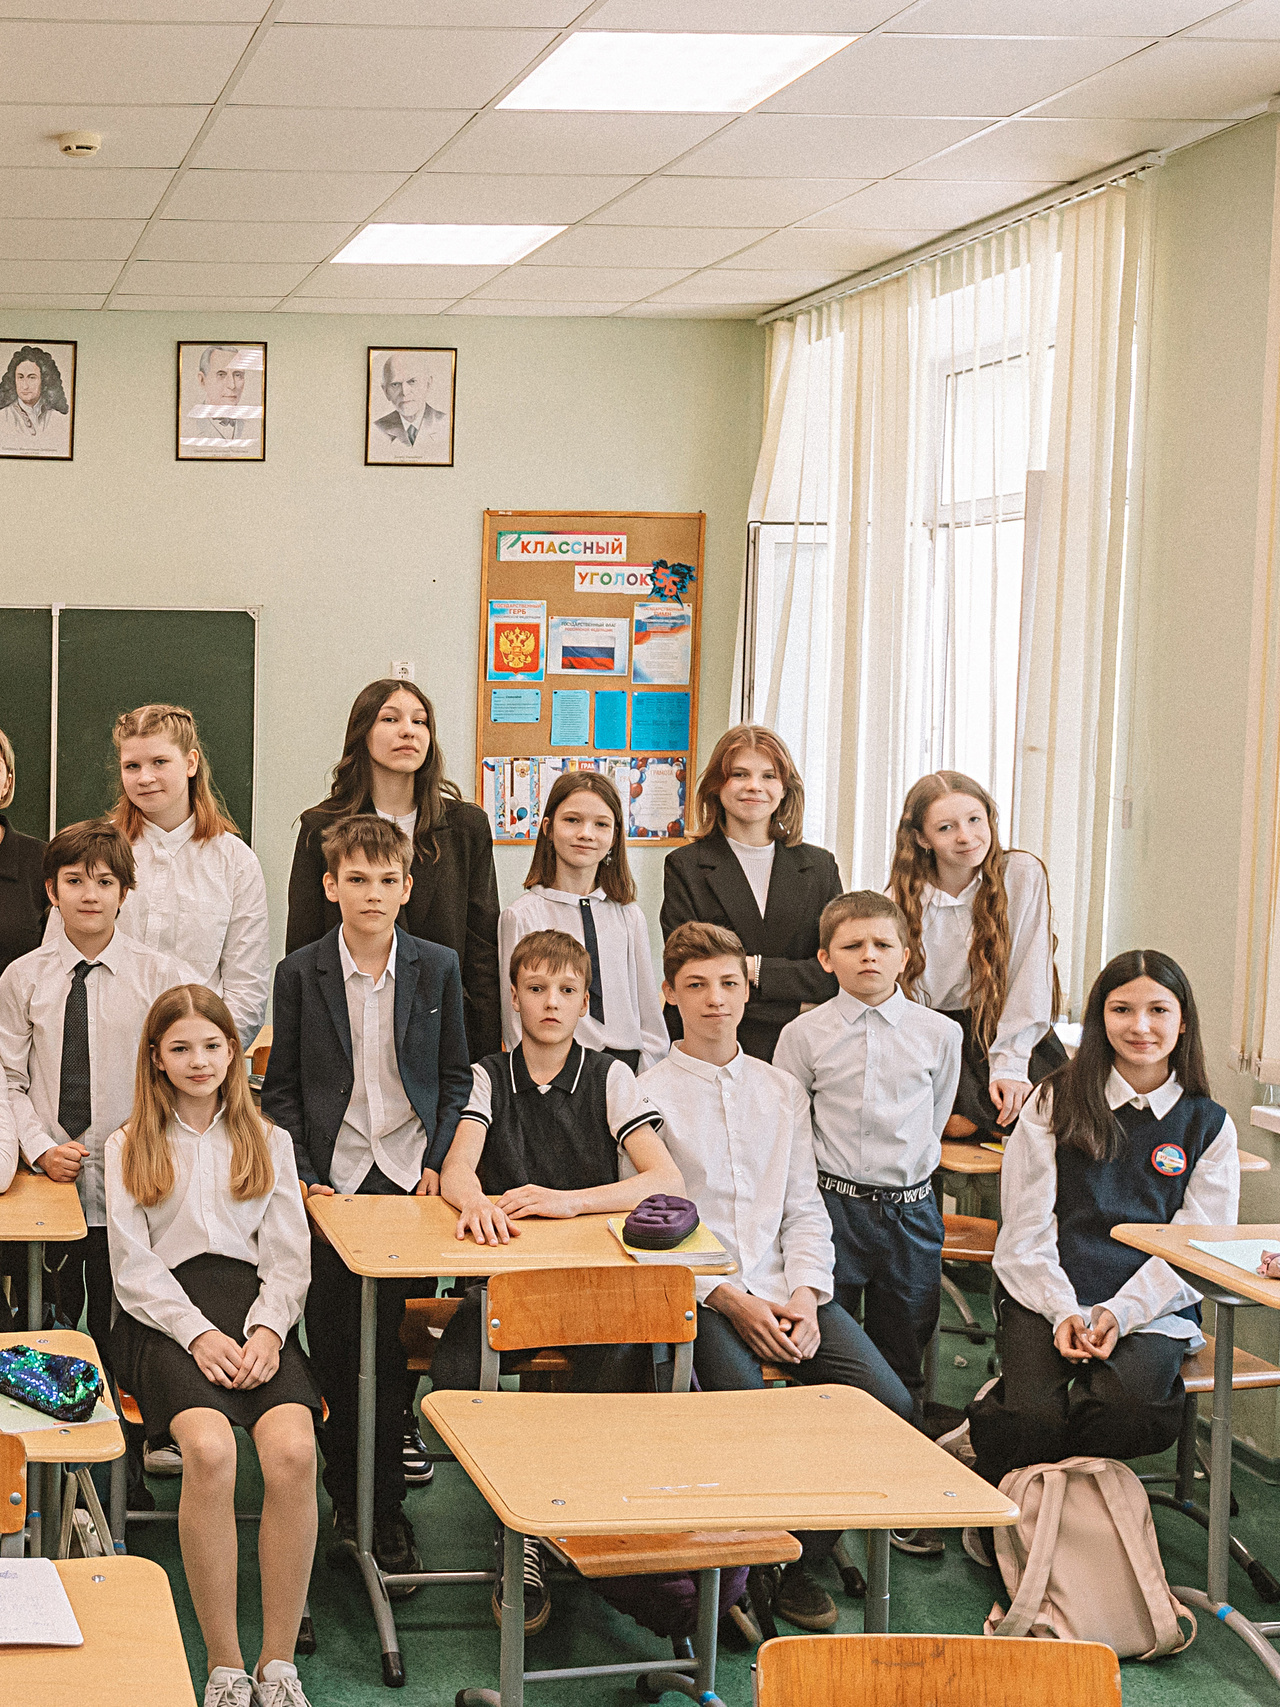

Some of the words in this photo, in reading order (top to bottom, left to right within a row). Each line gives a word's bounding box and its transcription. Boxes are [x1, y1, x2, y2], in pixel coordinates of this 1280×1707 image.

[520, 538, 623, 555] КЛАССНЫЙ
[577, 571, 651, 587] УГОЛОК
[654, 566, 681, 597] 5Б
